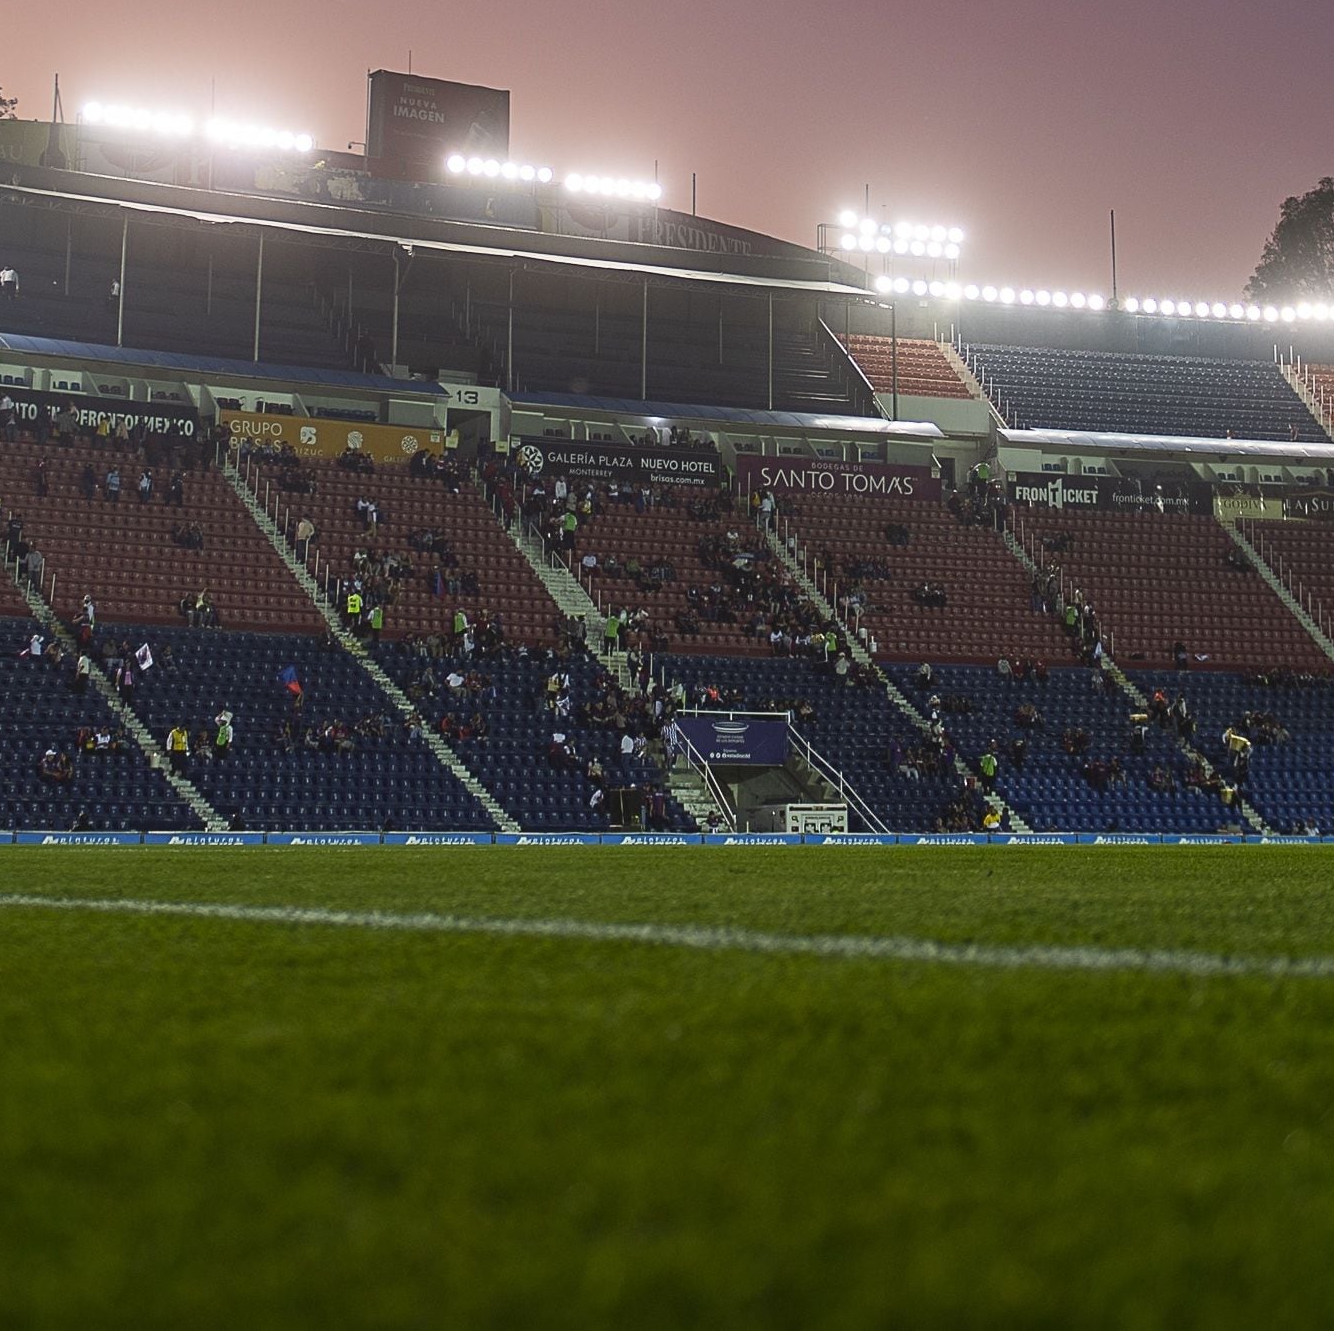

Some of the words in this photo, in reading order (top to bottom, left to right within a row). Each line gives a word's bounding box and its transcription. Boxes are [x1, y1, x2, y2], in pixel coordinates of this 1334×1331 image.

[400, 96, 437, 110] NUEVA
[394, 105, 444, 123] IMAGEN
[457, 390, 478, 404] 13
[230, 420, 282, 437] GRUPO
[547, 451, 596, 465] GALERÍA
[598, 455, 634, 468] PLAZA
[640, 457, 679, 471] NUEVO
[681, 461, 715, 474] HOTEL
[568, 468, 613, 477] MONTERREY
[811, 462, 850, 471] BODEGAS
[853, 464, 864, 472] DE
[650, 473, 705, 485] brisas.com.mx
[761, 467, 835, 490] SANTO
[1015, 481, 1098, 506] FRONTICKET
[1224, 499, 1267, 510] GODIVA
[1286, 498, 1303, 510] LA
